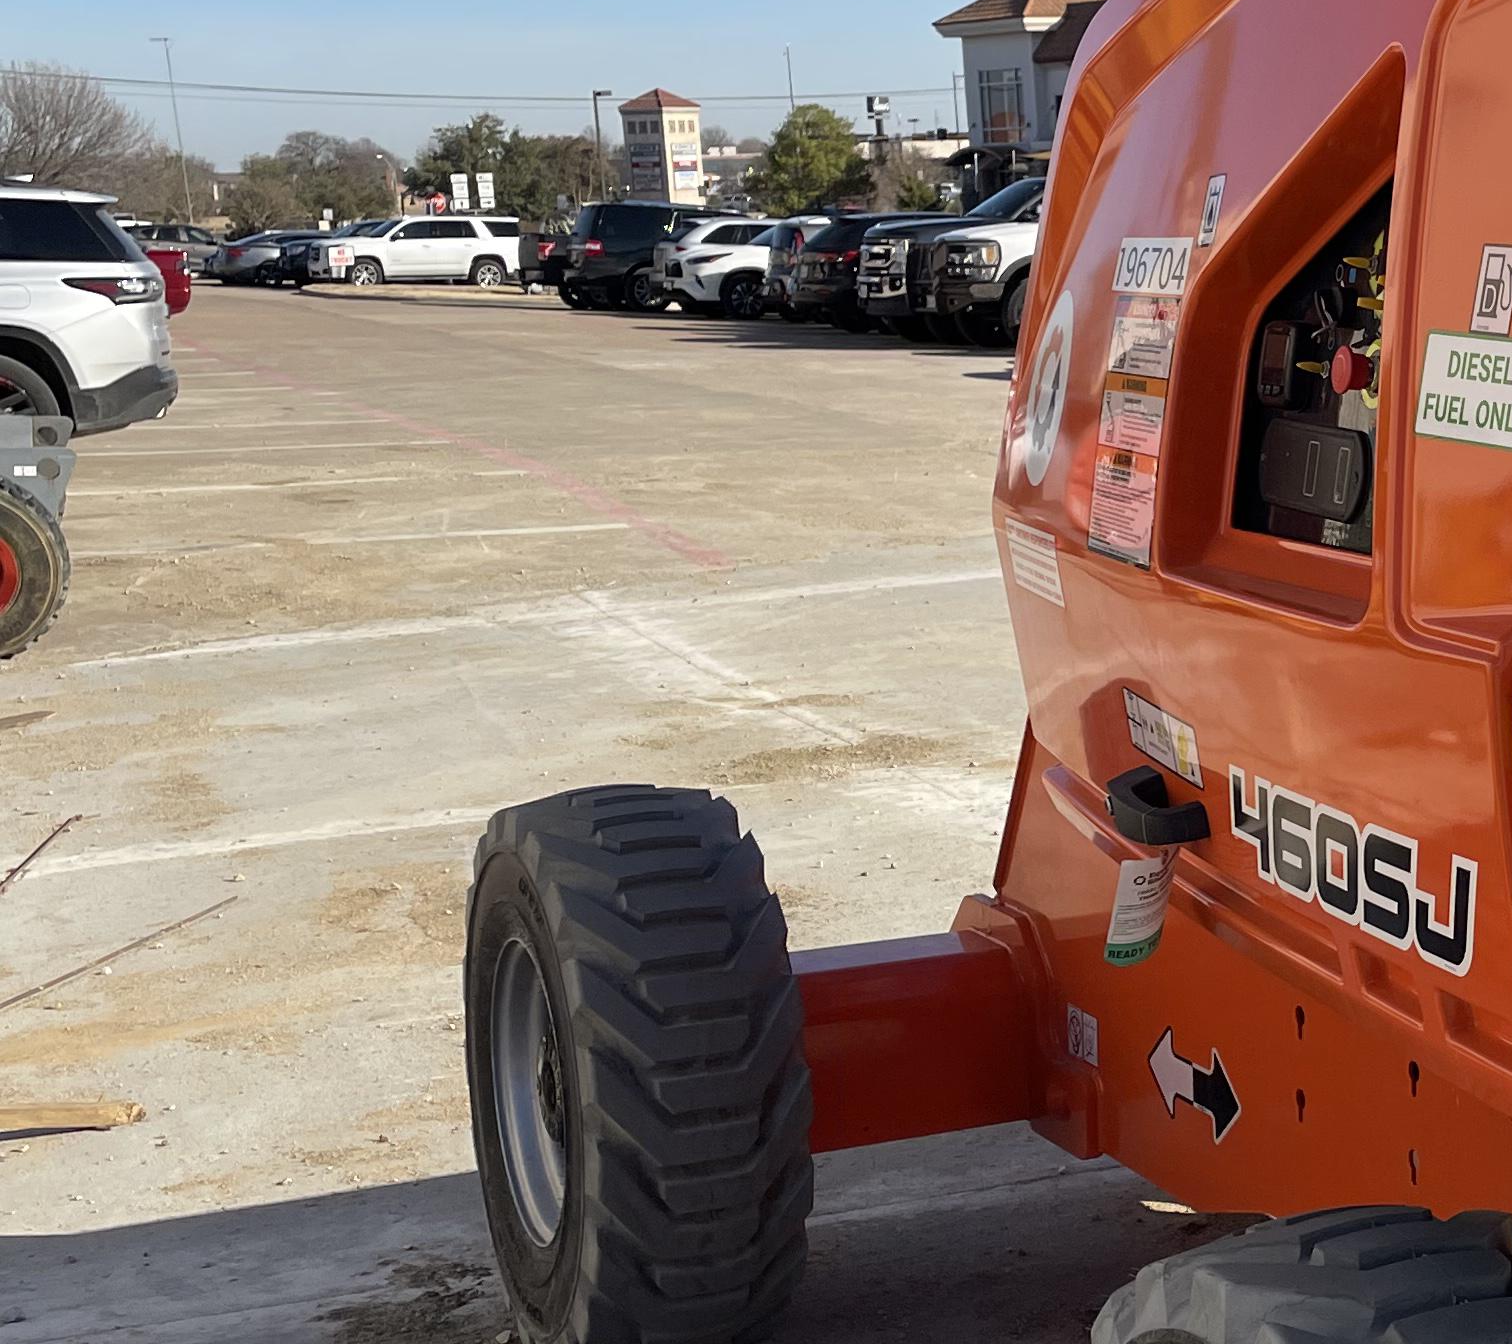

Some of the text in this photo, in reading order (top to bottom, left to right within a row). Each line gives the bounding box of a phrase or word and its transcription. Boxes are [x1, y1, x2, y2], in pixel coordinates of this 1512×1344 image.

[1115, 247, 1188, 290] 196704
[1422, 392, 1469, 427] FUEL
[1229, 764, 1478, 977] 460SJ
[1107, 946, 1145, 960] READY
